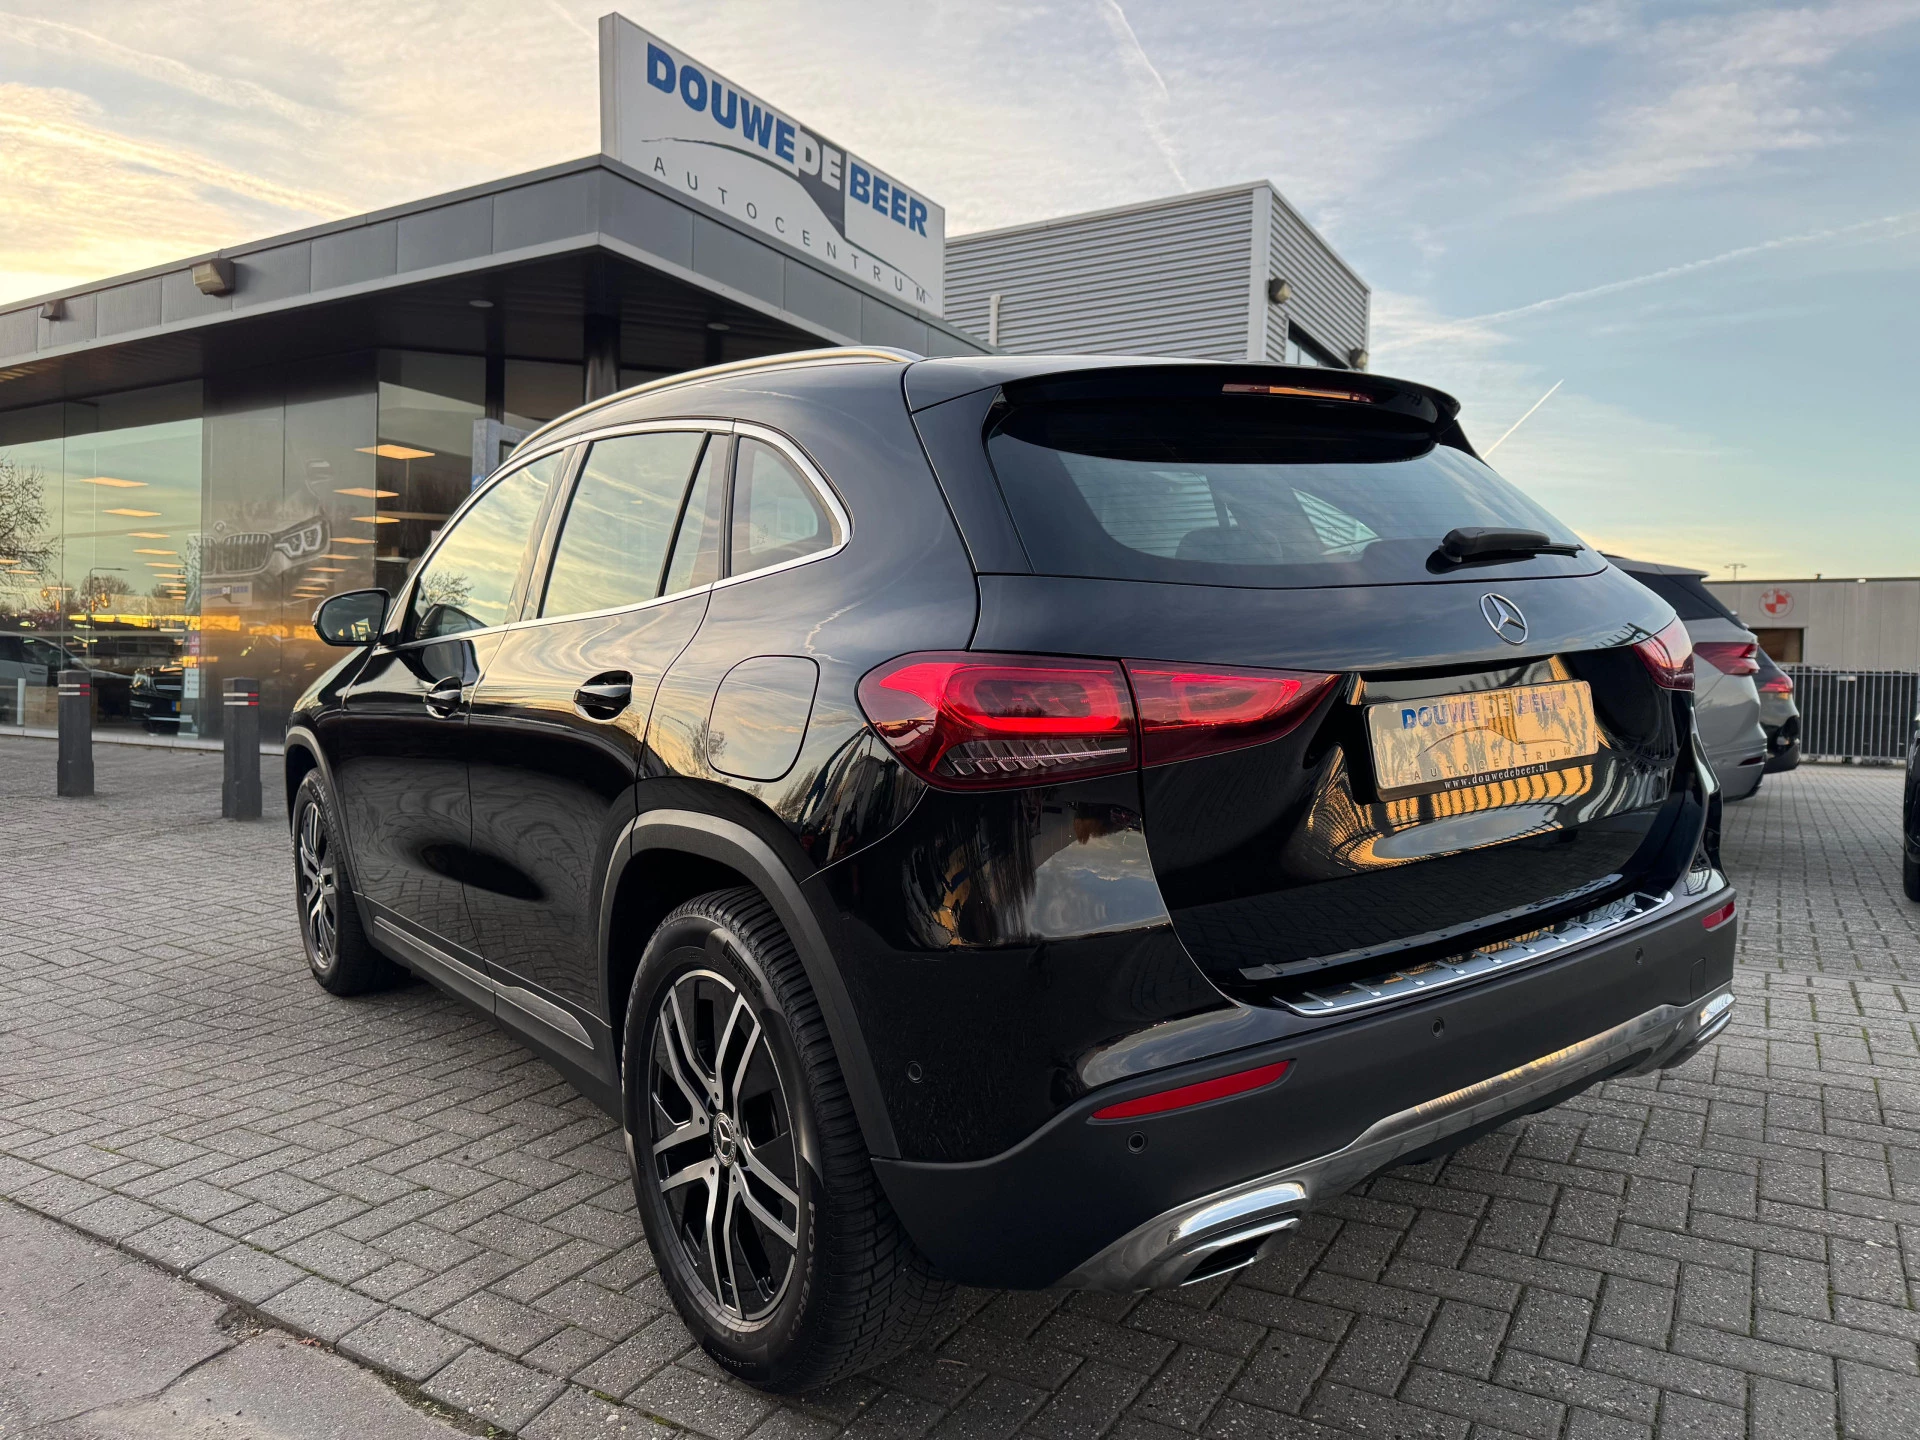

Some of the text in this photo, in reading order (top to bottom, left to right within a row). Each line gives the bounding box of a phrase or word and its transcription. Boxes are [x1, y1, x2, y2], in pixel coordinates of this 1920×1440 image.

[648, 42, 928, 238] DOUWE DE BEER
[654, 157, 926, 304] AUTOCENTRUM
[1401, 702, 1480, 730] DOUWE
[1515, 691, 1565, 714] BEER
[1414, 747, 1571, 780] AUTOCENTRUM
[1444, 763, 1549, 790] www.douwedebeer.nl
